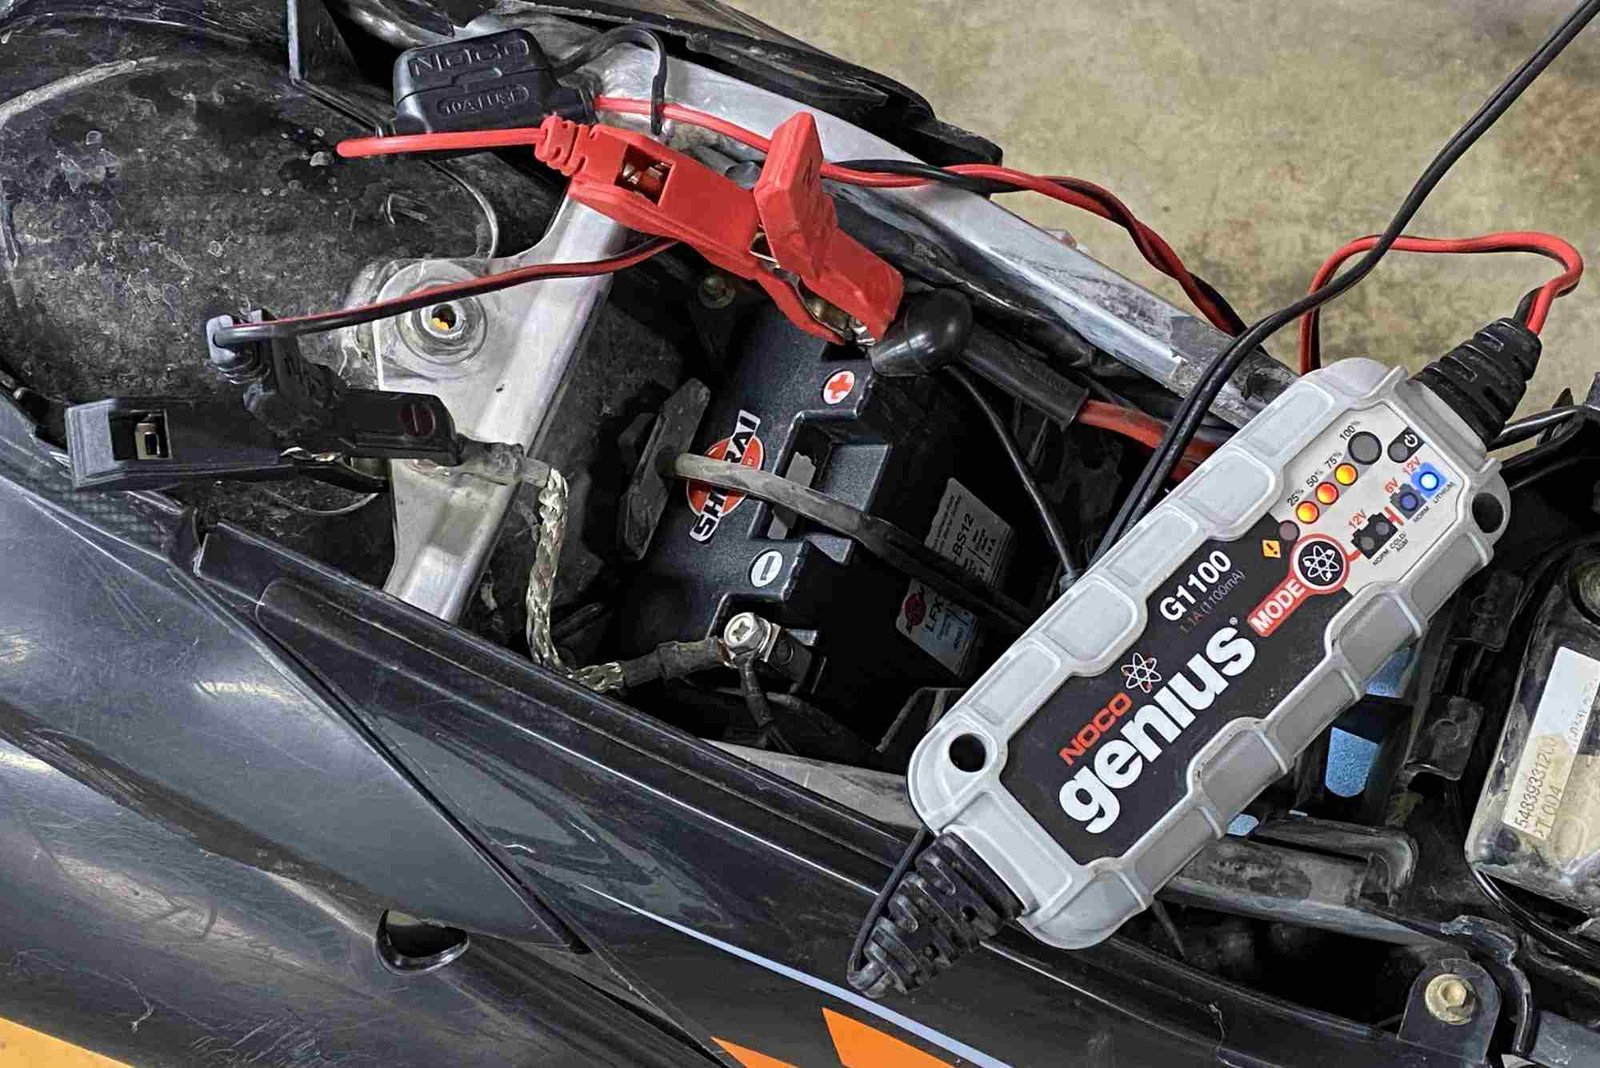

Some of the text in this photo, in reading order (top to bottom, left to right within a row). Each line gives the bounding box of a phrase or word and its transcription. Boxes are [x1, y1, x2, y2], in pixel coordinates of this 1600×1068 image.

[694, 415, 758, 537] SHRAI
[1402, 456, 1421, 475] 12V
[1384, 477, 1399, 494] 6V
[1433, 481, 1455, 504] LITHIUM
[1349, 509, 1368, 529] 12V
[1412, 505, 1430, 523] NORM
[1372, 548, 1390, 566] NORM
[1159, 550, 1231, 621] G1100
[1202, 570, 1246, 614] (1100mA)
[1251, 578, 1305, 632] MODE
[1058, 692, 1132, 767] NOCO
